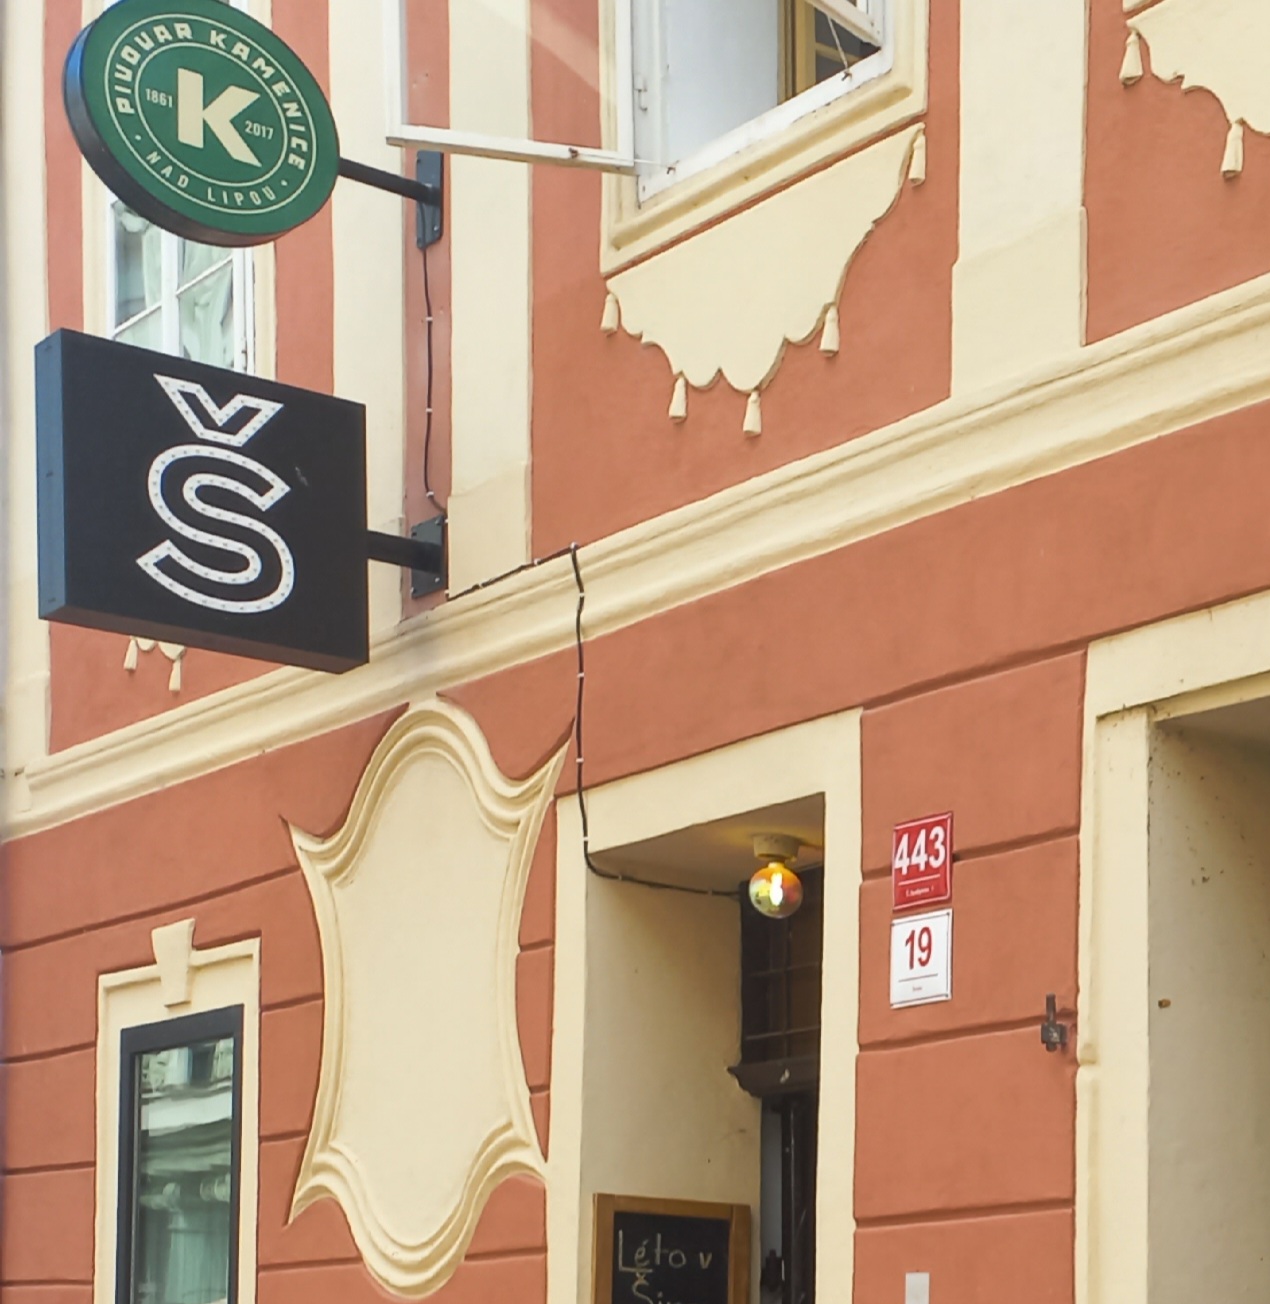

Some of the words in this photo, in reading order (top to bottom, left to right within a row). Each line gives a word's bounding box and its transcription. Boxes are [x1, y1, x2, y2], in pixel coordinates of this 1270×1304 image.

[145, 88, 174, 108] 1861
[177, 67, 262, 168] K
[209, 29, 309, 171] KAMENICE
[244, 120, 274, 140] 2017
[146, 151, 190, 189] NAD
[206, 185, 277, 207] LIPOU
[135, 373, 295, 614] Š
[894, 825, 946, 876] 443
[905, 926, 933, 970] 19
[618, 1229, 687, 1273] Léto
[699, 1251, 713, 1270] v
